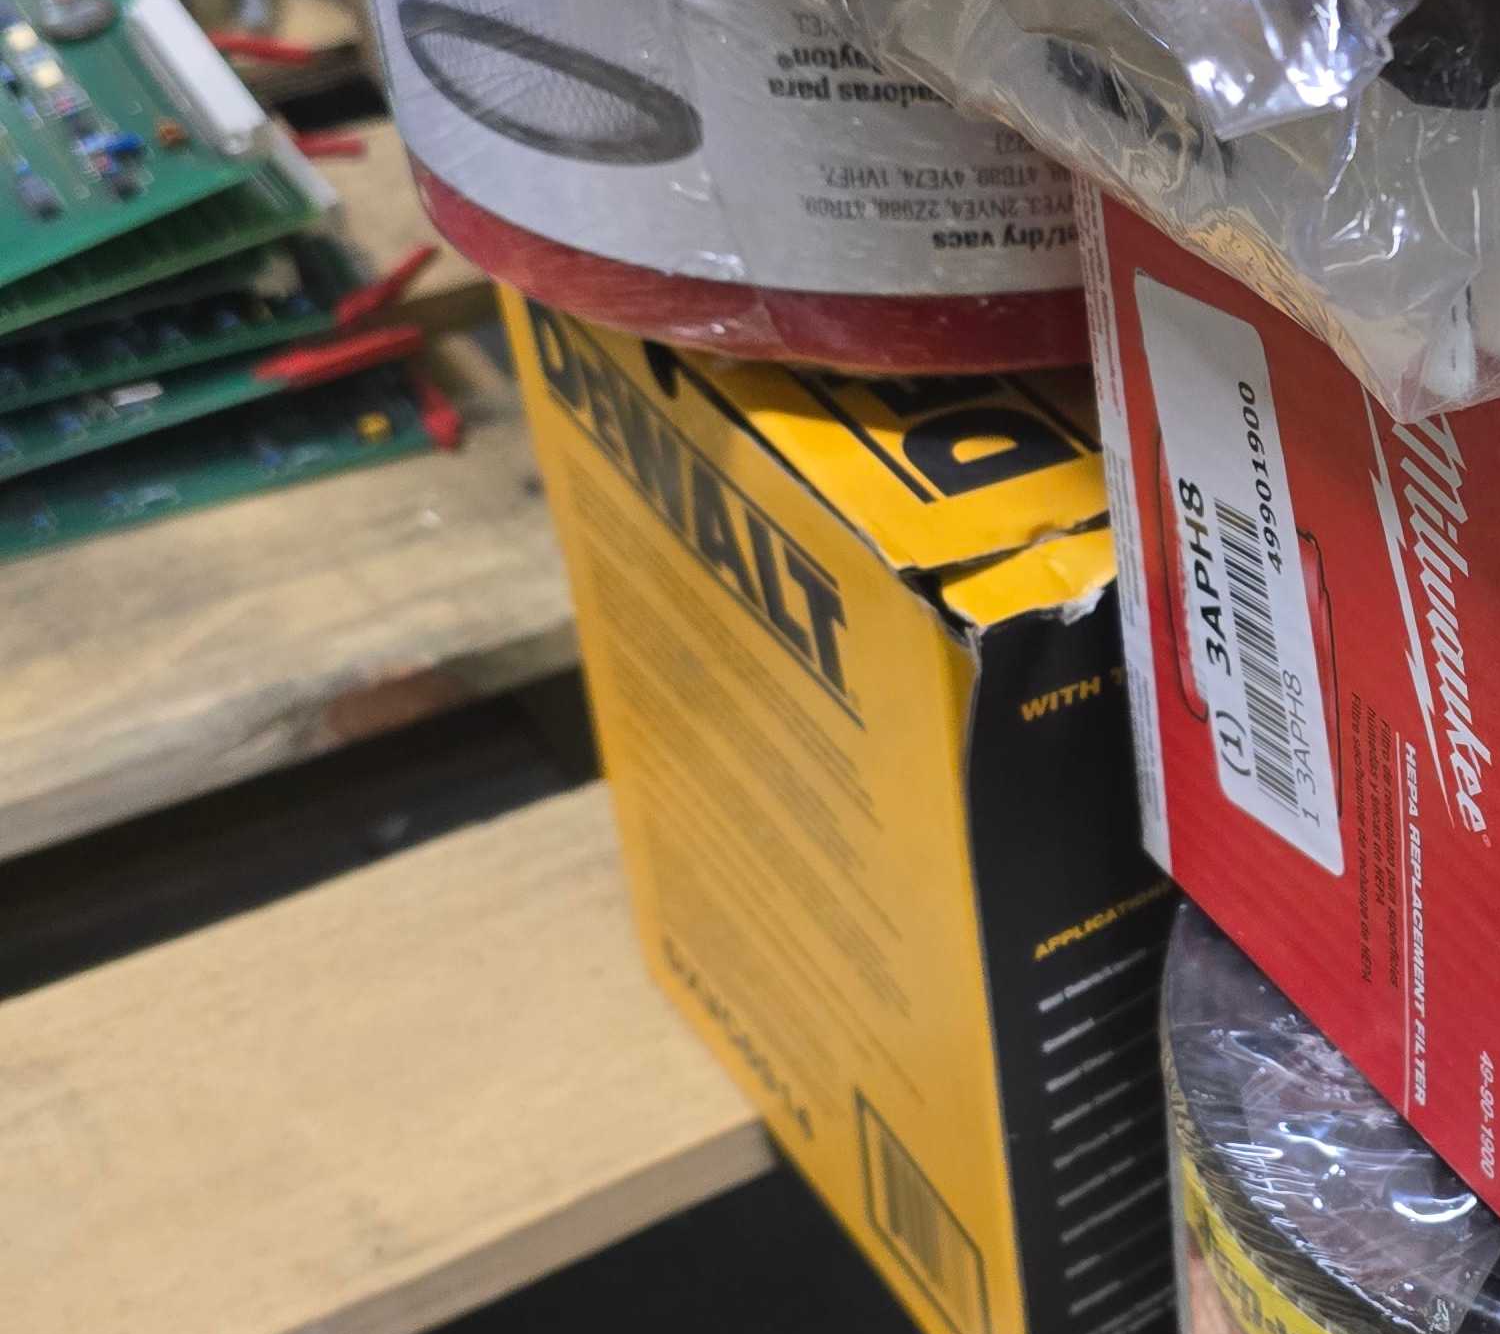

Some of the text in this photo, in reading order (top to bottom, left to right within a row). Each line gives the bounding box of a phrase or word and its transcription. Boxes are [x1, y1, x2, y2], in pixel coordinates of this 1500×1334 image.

[767, 76, 833, 103] para
[931, 228, 997, 252] vacs
[1236, 379, 1285, 577] 49901900
[1178, 477, 1252, 779] (1) 3APH8
[1391, 407, 1494, 836] Milwaukee
[1021, 675, 1101, 722] WITH
[1279, 668, 1319, 798] 3APH8
[1405, 742, 1428, 1106] HEPA REPLACEMENT FILTER
[1478, 1049, 1496, 1180] 49-90-1900
